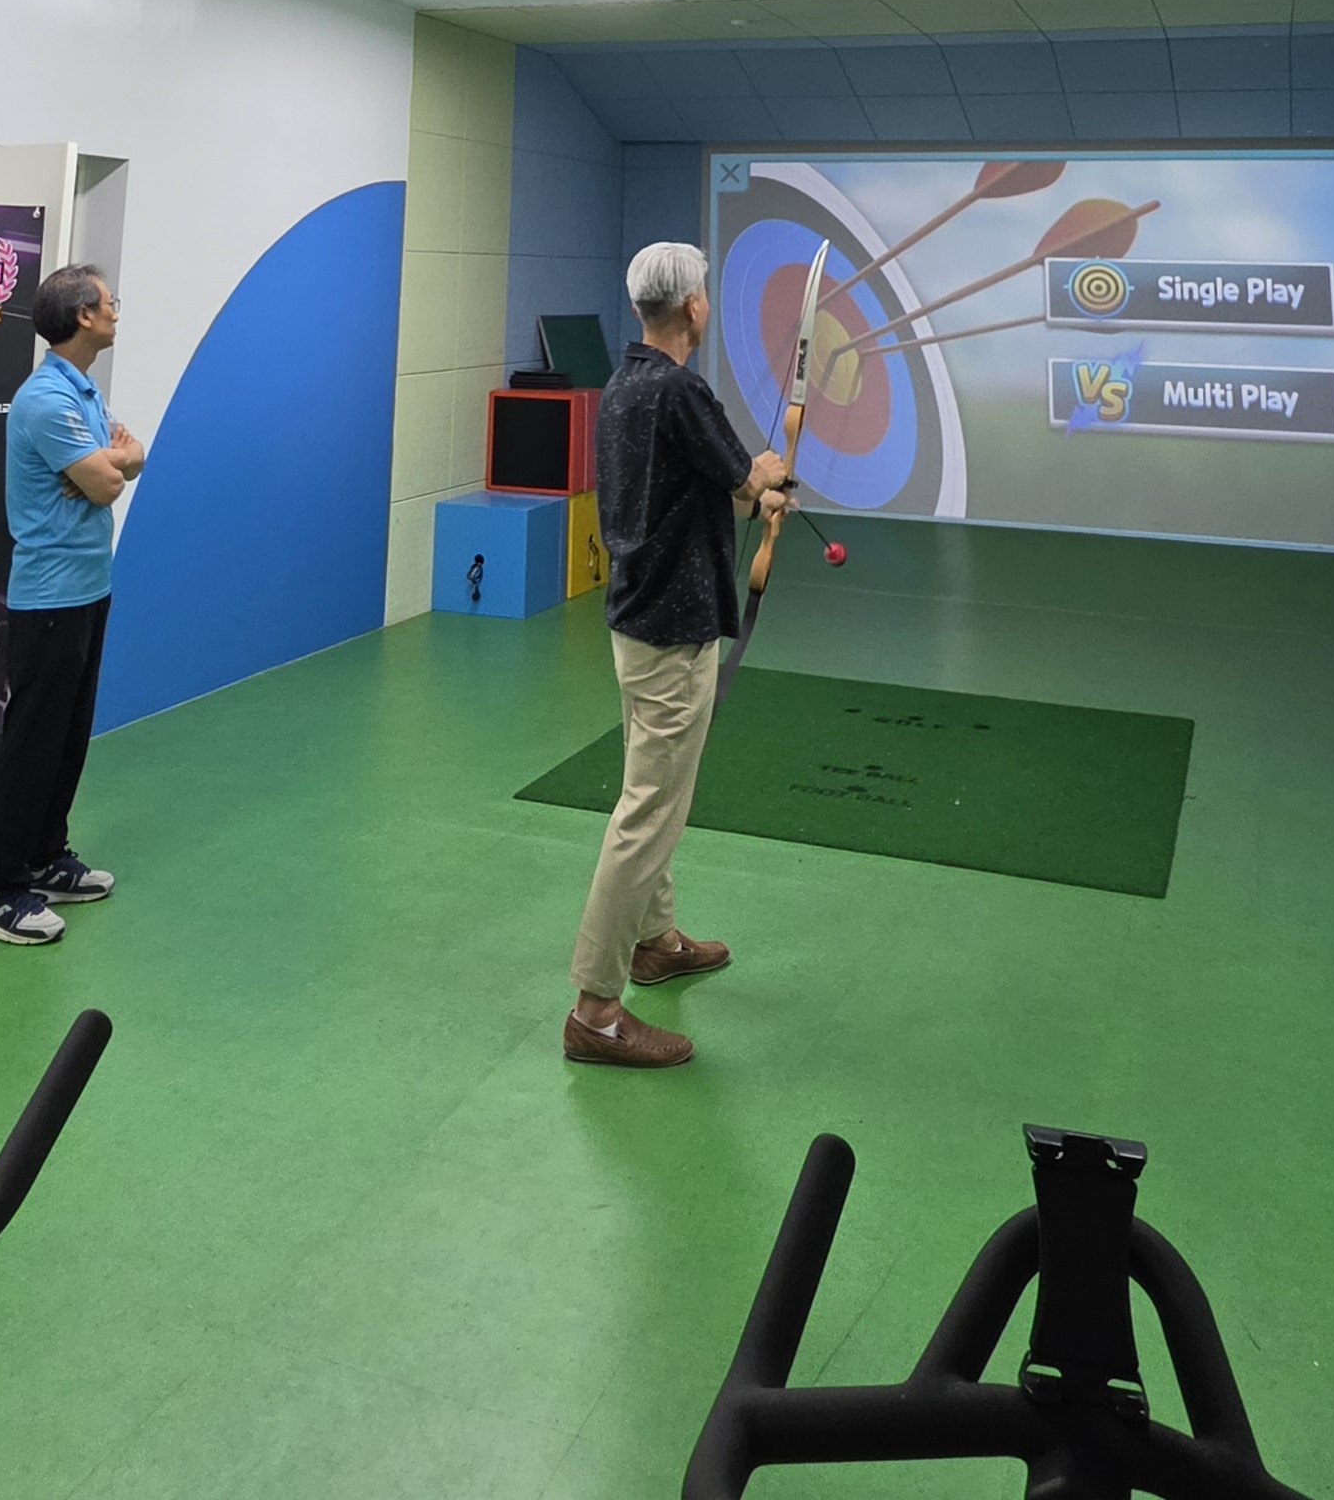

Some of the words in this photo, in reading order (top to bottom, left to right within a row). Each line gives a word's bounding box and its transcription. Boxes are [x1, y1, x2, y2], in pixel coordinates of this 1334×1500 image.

[1157, 276, 1240, 308] Single
[1246, 277, 1305, 310] Play
[1076, 363, 1130, 423] VS
[1163, 380, 1234, 409] Multi
[1241, 384, 1299, 418] Play
